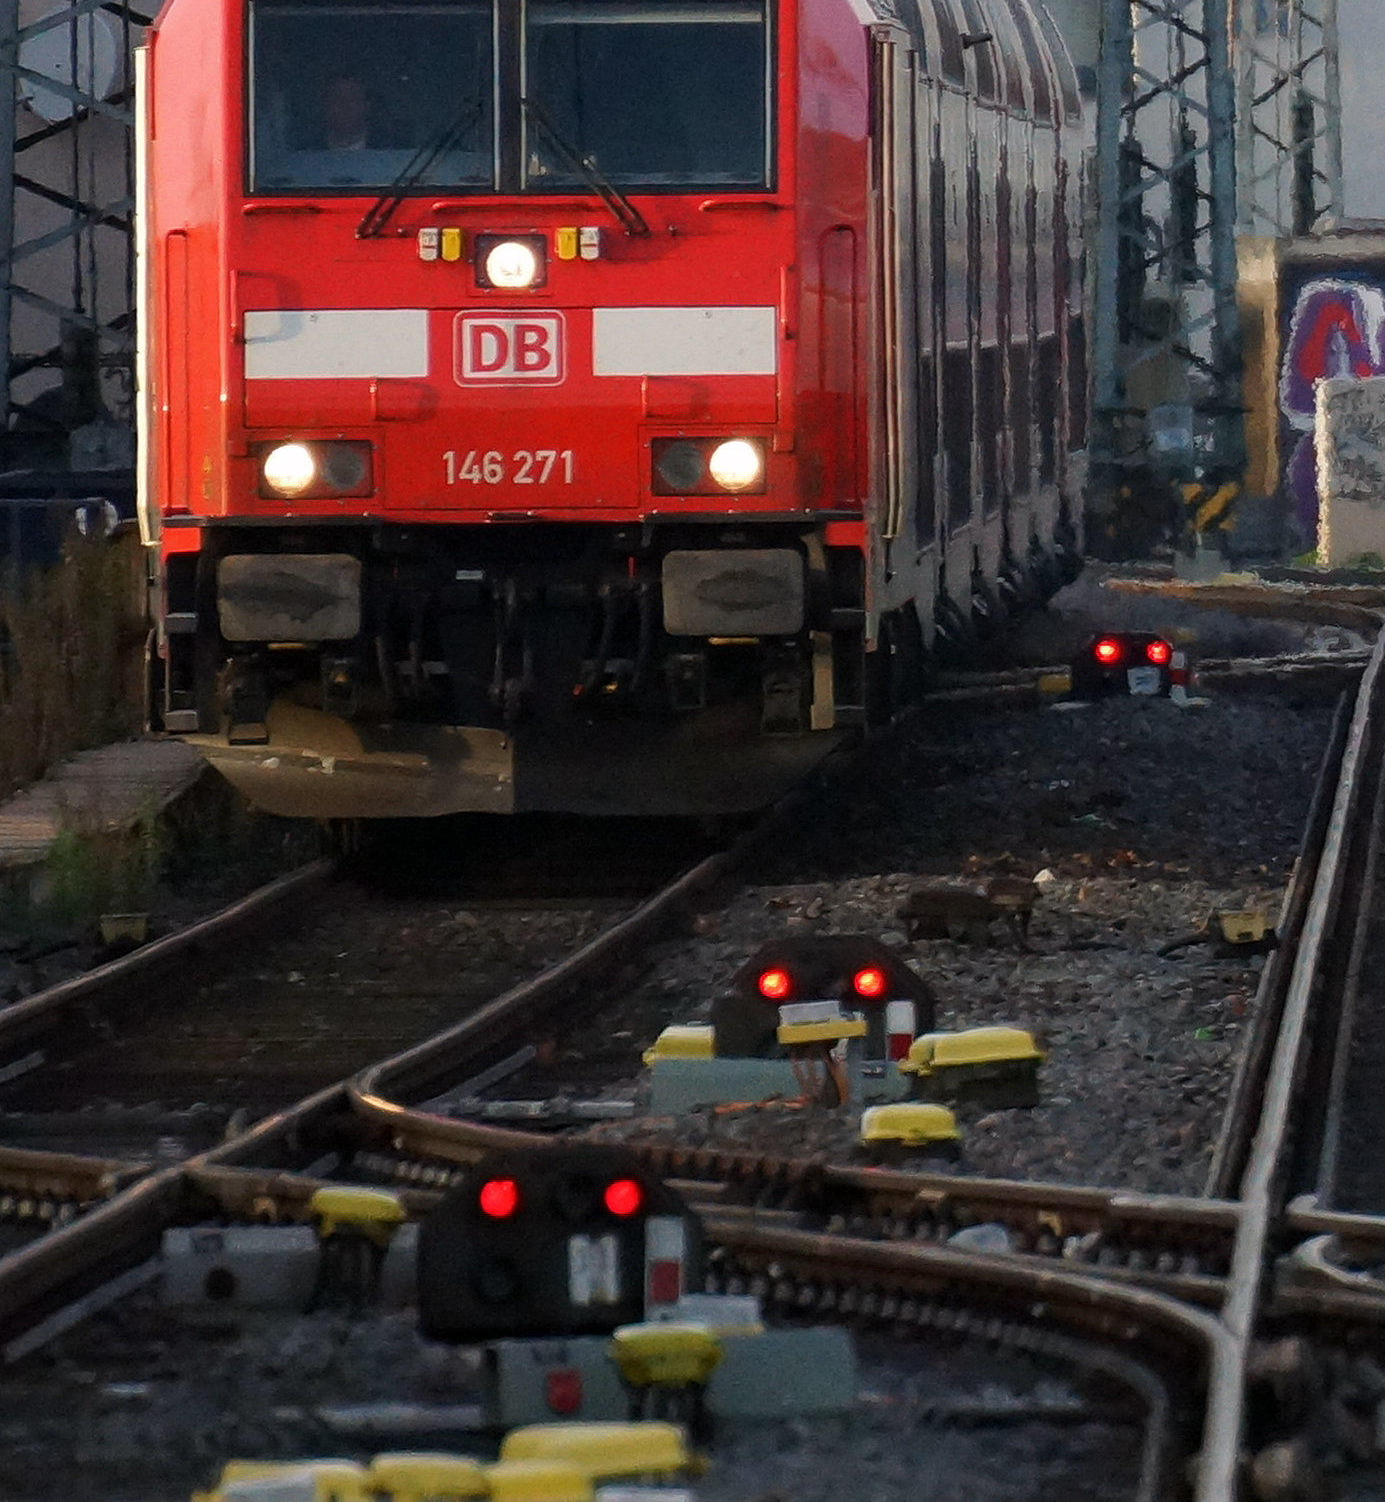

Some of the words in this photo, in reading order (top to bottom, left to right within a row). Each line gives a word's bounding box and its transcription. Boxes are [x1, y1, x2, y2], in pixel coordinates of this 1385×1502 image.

[469, 323, 552, 373] DB
[442, 449, 504, 485] 146
[512, 449, 574, 485] 271
